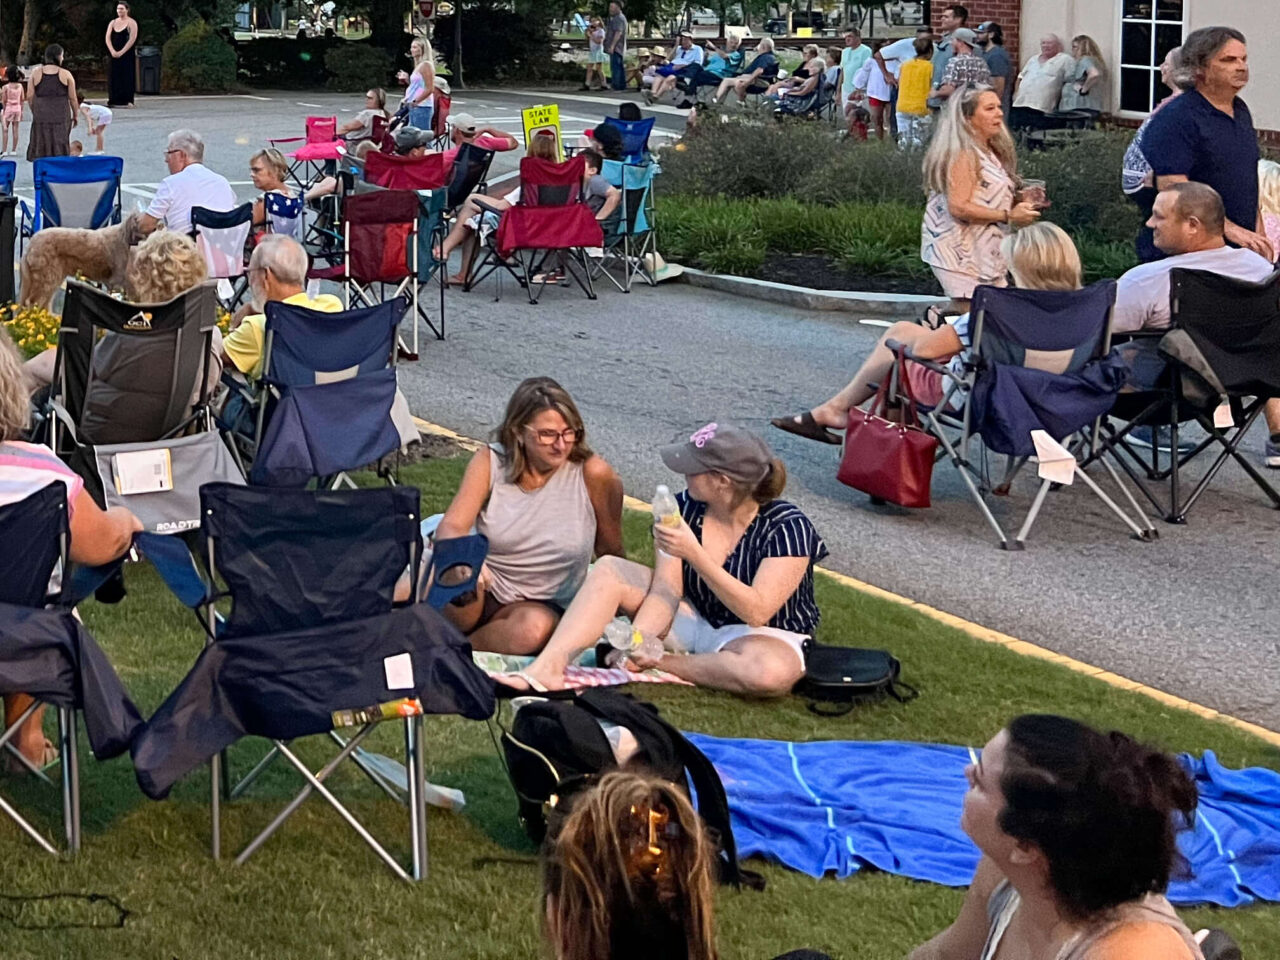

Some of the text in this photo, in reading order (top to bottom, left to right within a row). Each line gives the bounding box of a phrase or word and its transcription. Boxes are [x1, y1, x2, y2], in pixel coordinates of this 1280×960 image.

[528, 108, 553, 118] STATE
[533, 117, 550, 126] LAW
[156, 520, 201, 531] ROADTR
